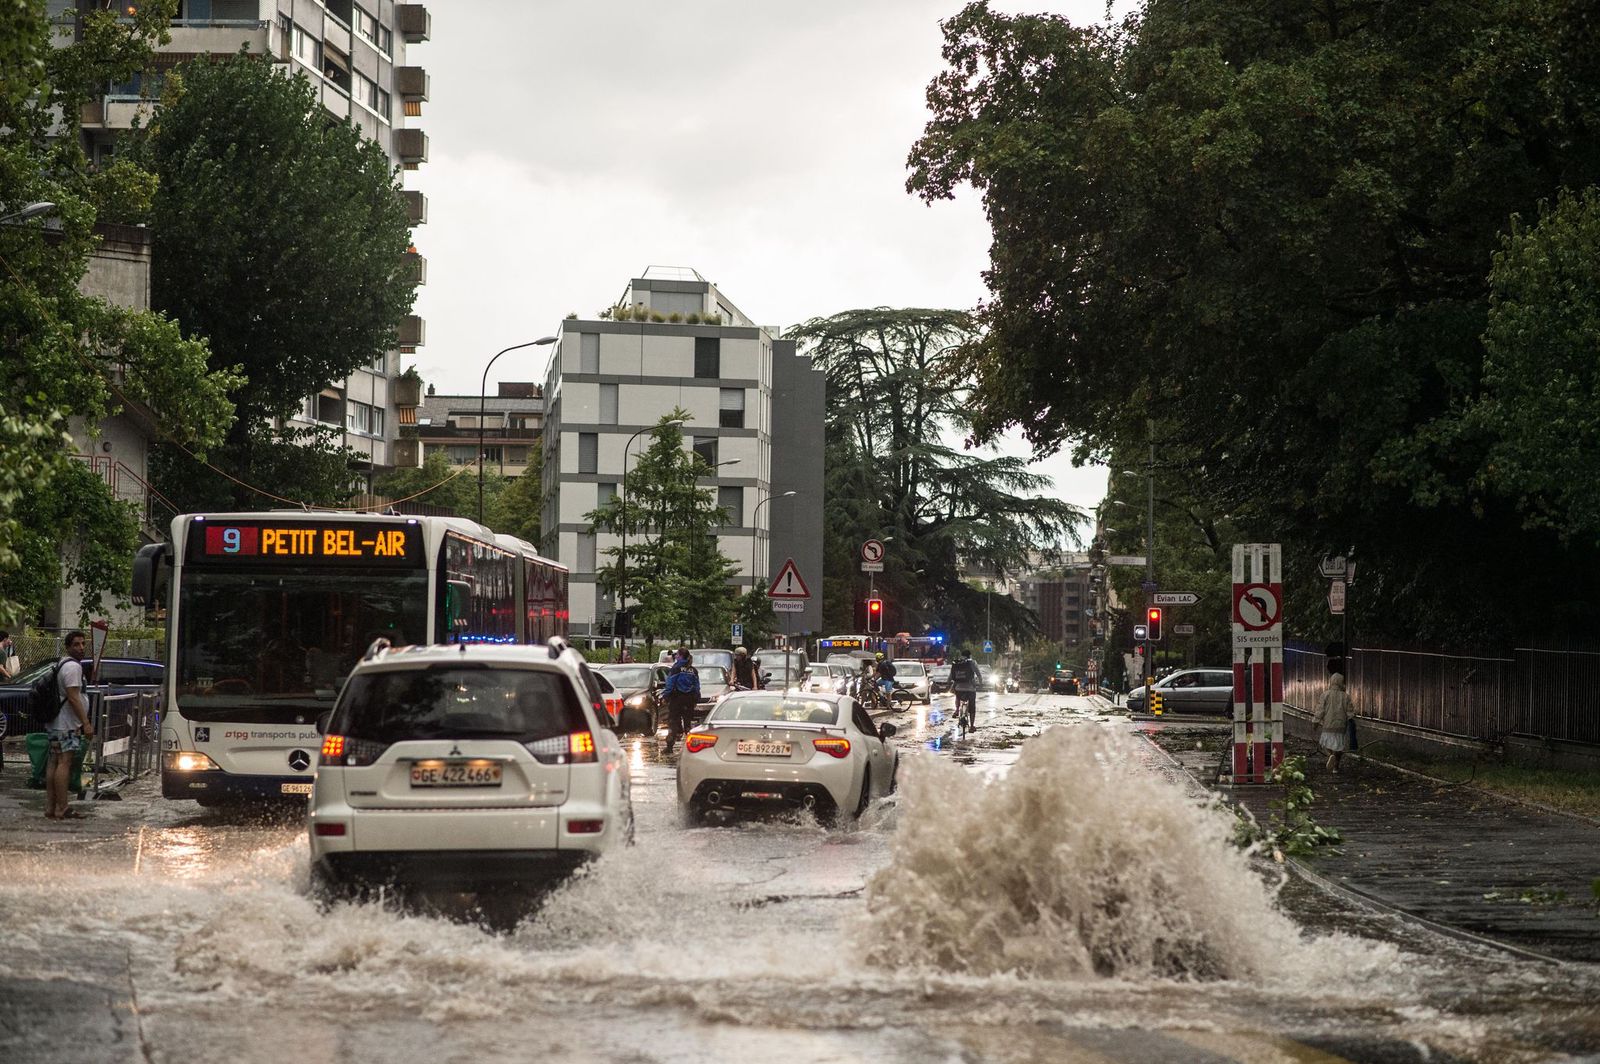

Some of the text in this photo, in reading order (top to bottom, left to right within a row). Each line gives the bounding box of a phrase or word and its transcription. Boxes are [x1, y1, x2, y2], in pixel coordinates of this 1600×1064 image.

[223, 528, 406, 556] 9 PETIT BEL-AIR
[1157, 594, 1176, 602] Evian
[1250, 635, 1279, 643] exceptés
[233, 731, 248, 740] tpg
[251, 731, 296, 740] transports
[744, 742, 785, 753] GE 892287
[421, 768, 491, 782] GE 422466
